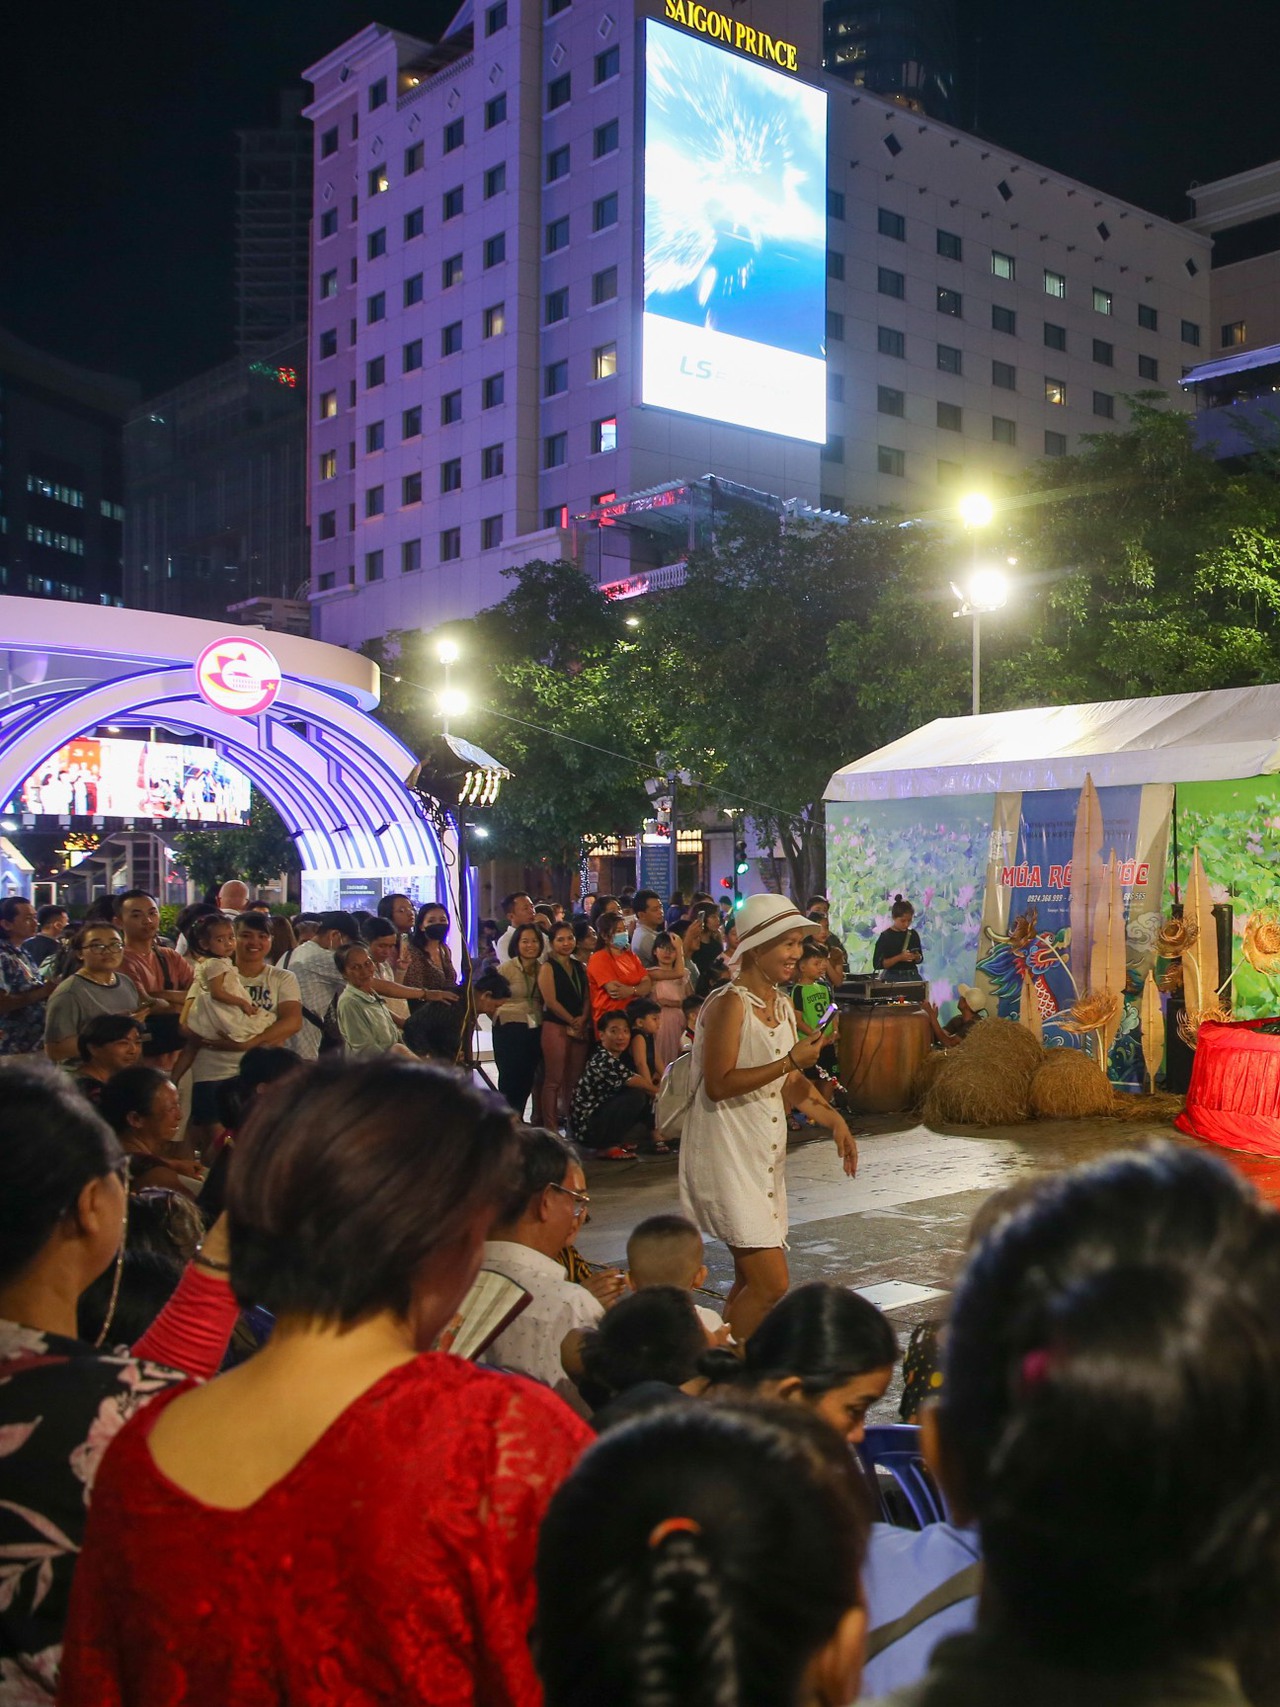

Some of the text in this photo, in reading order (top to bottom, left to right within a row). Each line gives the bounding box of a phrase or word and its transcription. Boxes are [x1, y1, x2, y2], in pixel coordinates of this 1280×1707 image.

[665, 0, 798, 72] SAIGON PRINCE
[1001, 860, 1042, 888] MÚA
